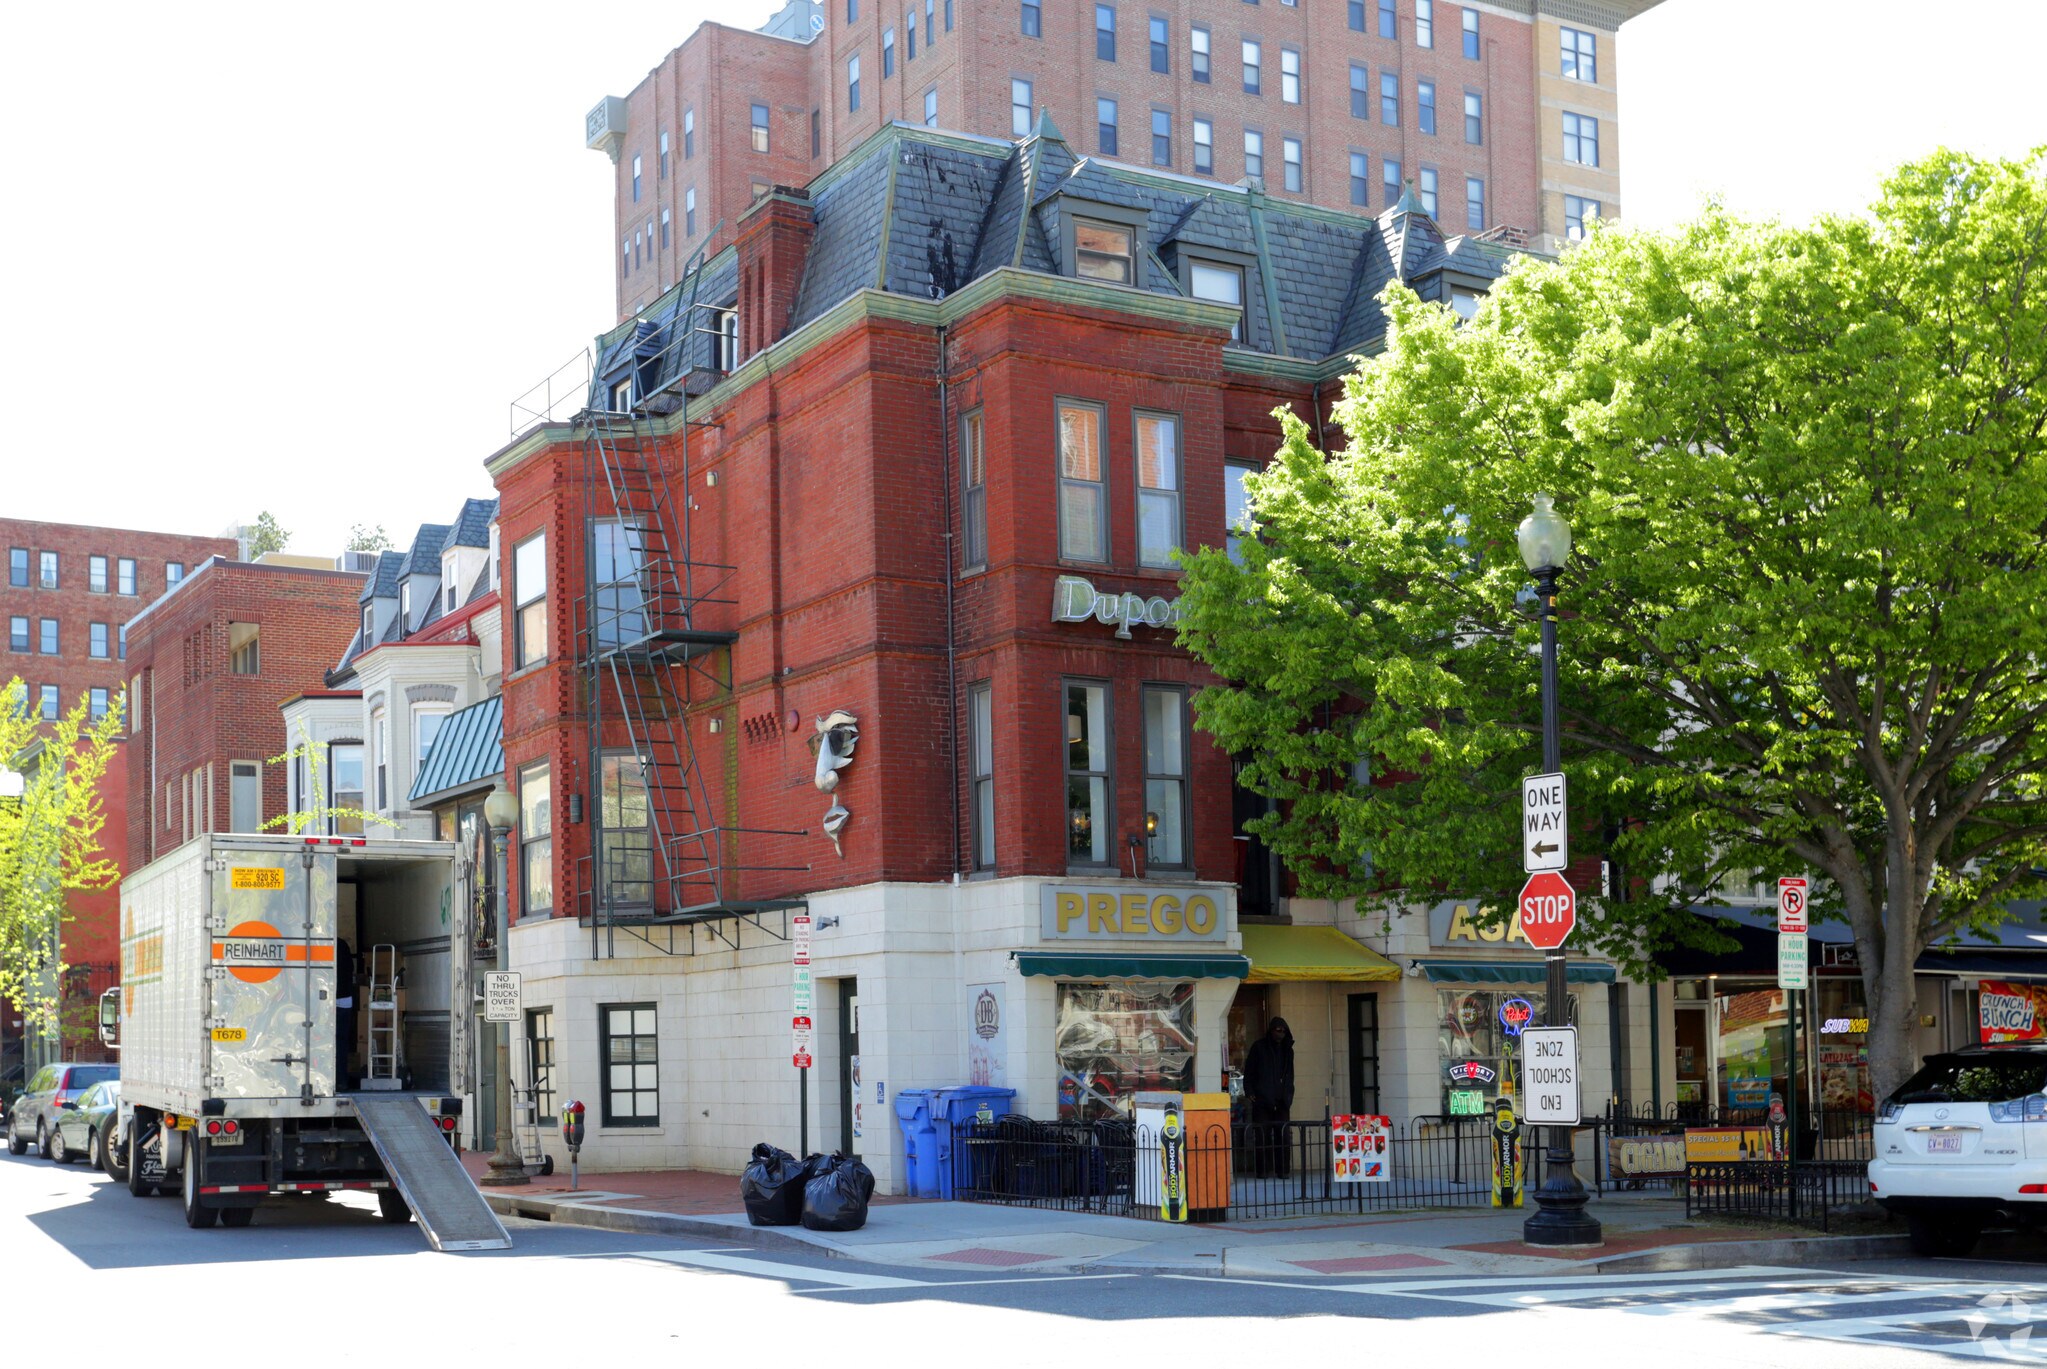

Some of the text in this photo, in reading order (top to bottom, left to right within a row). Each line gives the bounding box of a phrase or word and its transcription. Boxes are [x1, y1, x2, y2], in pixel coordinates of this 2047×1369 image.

[1527, 786, 1561, 808] ONE
[1527, 811, 1562, 833] WAY
[256, 873, 269, 882] 920
[270, 873, 280, 882] SC
[1056, 892, 1217, 935] PREGO
[1524, 894, 1570, 925] STOP
[225, 943, 284, 960] REINHART
[1788, 940, 1804, 950] HOUR
[1780, 951, 1806, 961] PARKING
[496, 975, 510, 983] NO
[489, 990, 519, 998] TRUCKS
[1981, 993, 2025, 1010] CRUNCH
[491, 998, 515, 1006] OVER
[980, 1000, 994, 1024] DB
[1505, 1007, 1529, 1022] Pabst
[1981, 1007, 2033, 1030] BUNCH
[216, 1030, 242, 1040] T678
[1453, 1065, 1491, 1078] VICTORY
[1529, 1068, 1572, 1083] SCHOOL
[1450, 1091, 1484, 1115] ATM
[1540, 1095, 1562, 1110] END
[1688, 1135, 1719, 1144] SPECIAL
[1928, 1138, 1937, 1149] CV
[1502, 1134, 1511, 1188] BODYARMOR
[1620, 1141, 1687, 1174] CIGARS
[1168, 1141, 1178, 1199] BODYARMOR
